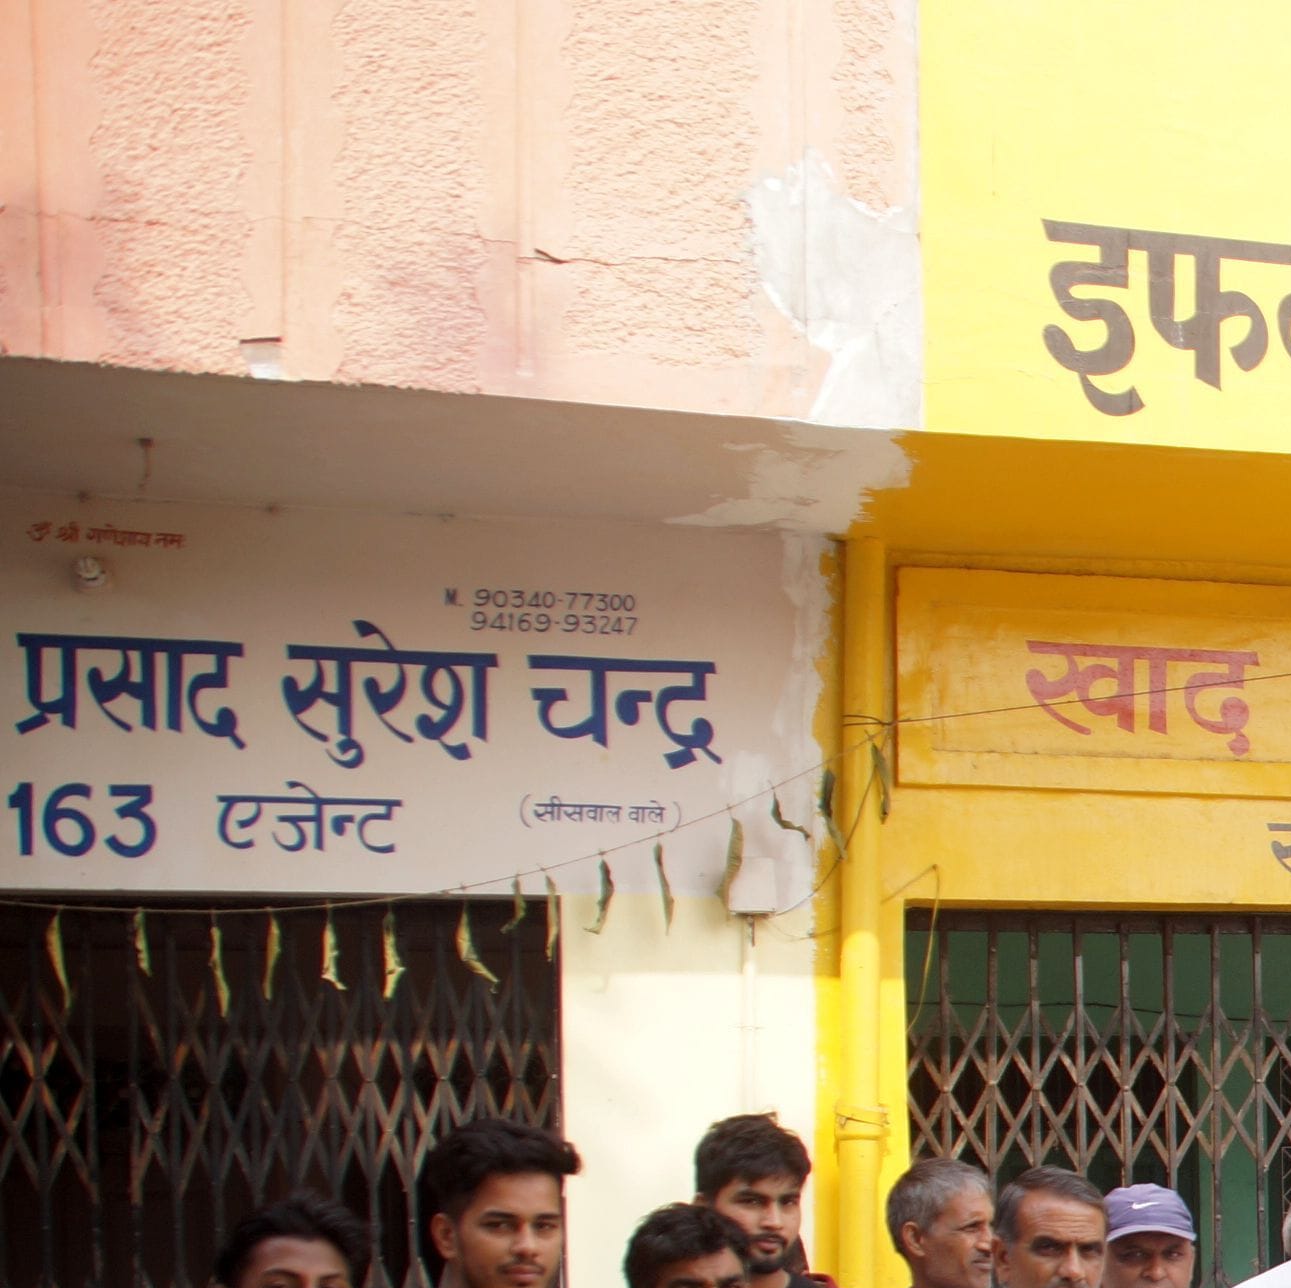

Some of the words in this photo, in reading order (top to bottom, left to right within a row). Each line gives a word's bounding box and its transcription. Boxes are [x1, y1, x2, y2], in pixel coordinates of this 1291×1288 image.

[470, 611, 638, 636] 94169-93247
[474, 588, 636, 612] 90340-77300
[15, 631, 247, 750] प्रसाद
[281, 619, 499, 770] सुरेश
[526, 654, 723, 770] चन्द्र
[1025, 640, 1260, 756] खाद
[8, 782, 157, 858] 163
[216, 780, 403, 854] एजेन्ट
